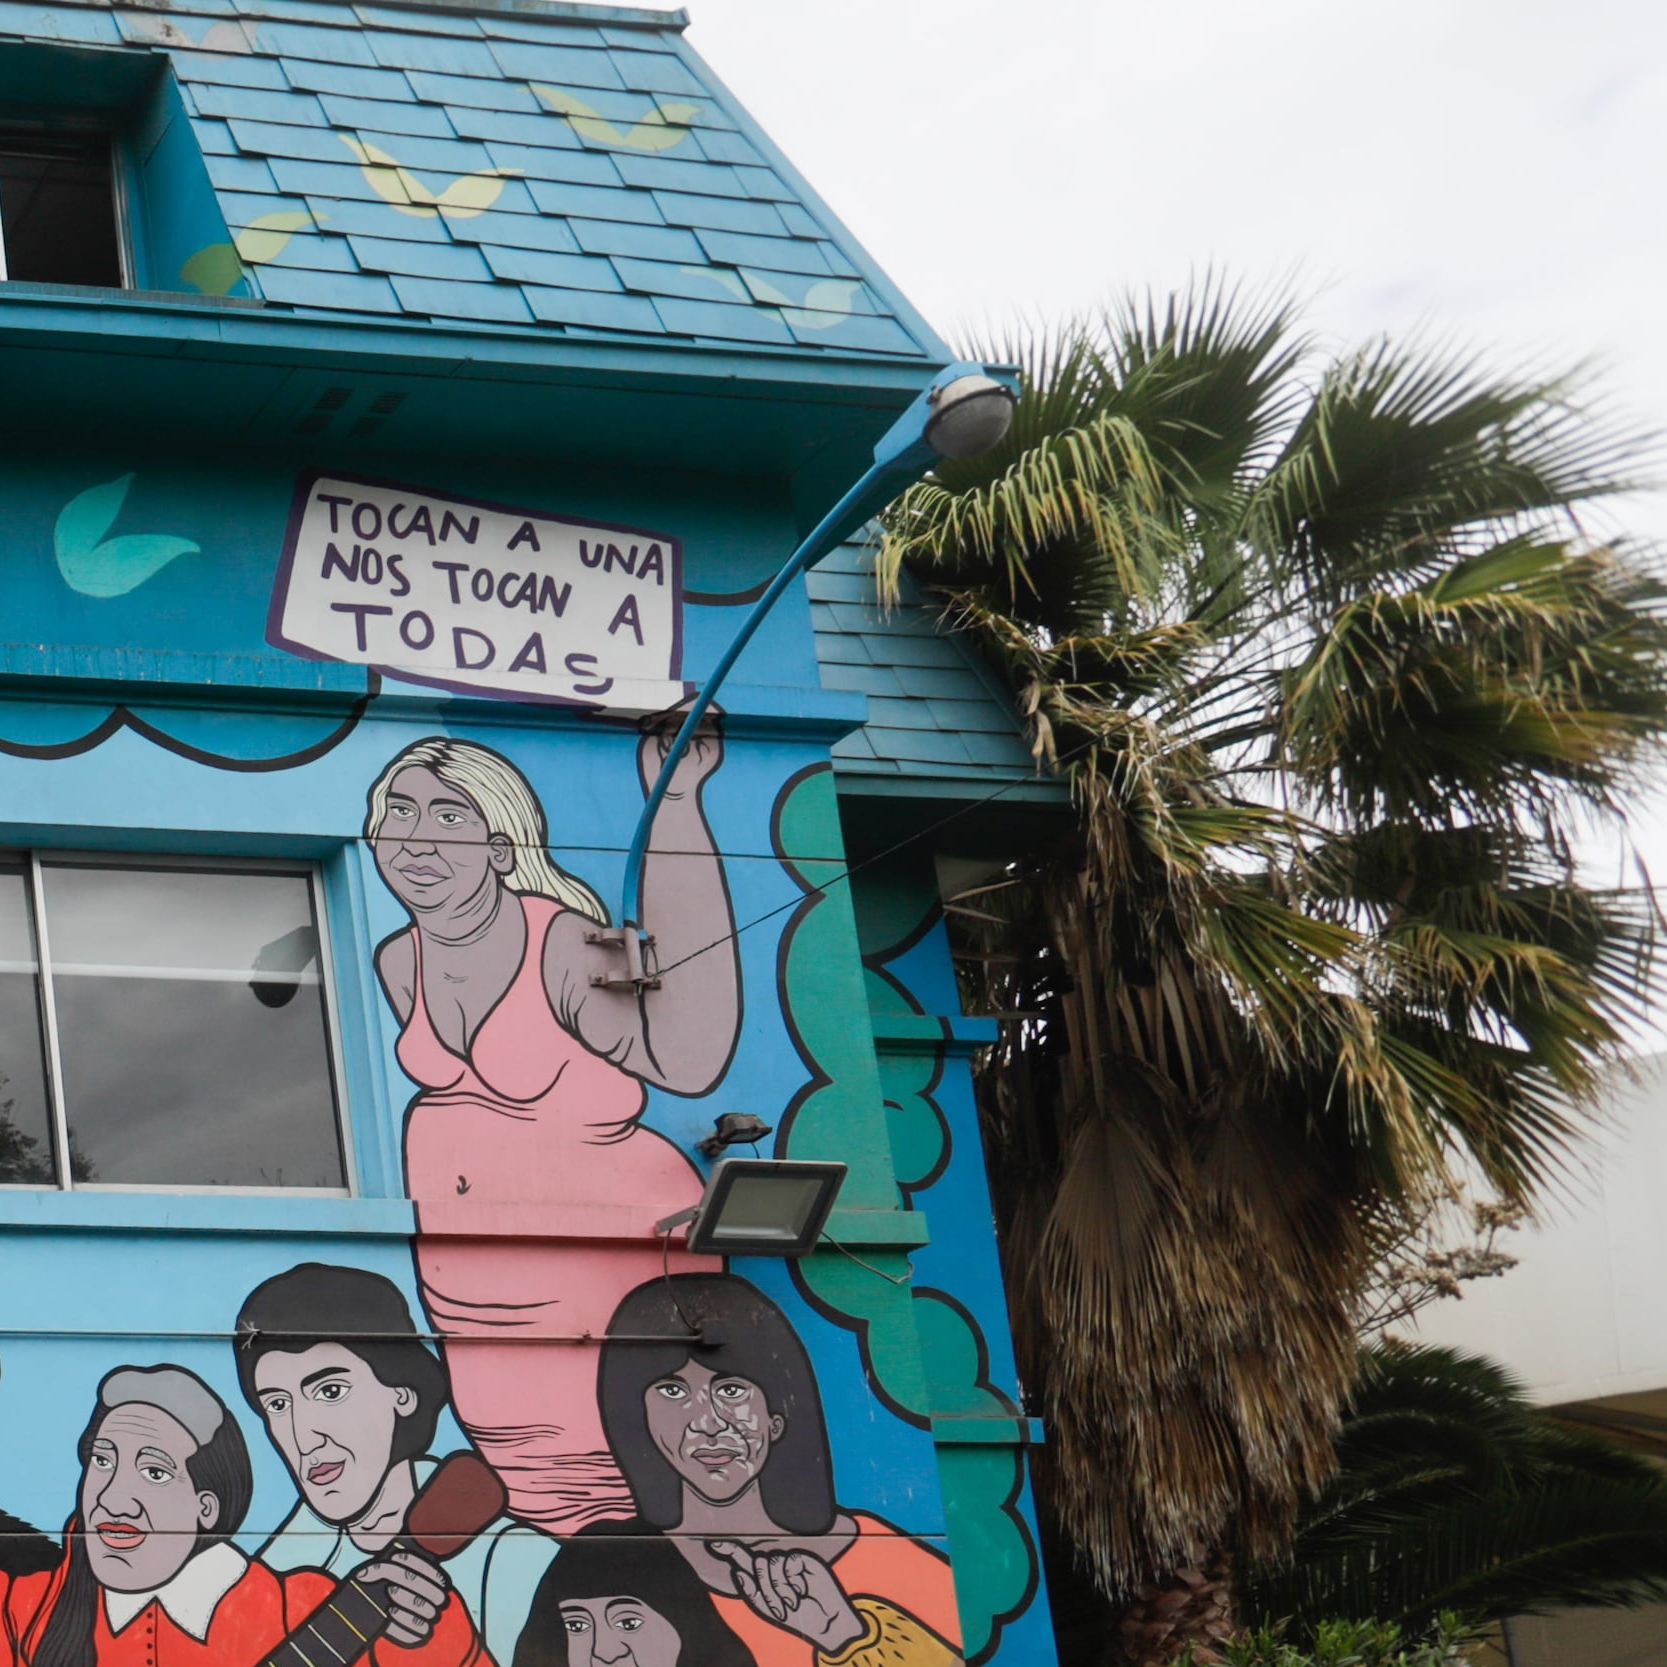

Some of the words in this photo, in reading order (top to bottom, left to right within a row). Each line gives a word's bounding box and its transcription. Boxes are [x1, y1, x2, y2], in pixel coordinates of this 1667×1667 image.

[317, 494, 480, 546] TOCAN
[507, 521, 541, 552] A
[579, 539, 664, 586] UNA
[321, 542, 411, 597] NOS
[432, 560, 572, 618] TOCAN
[607, 593, 644, 646] A
[330, 602, 614, 695] TODAS
